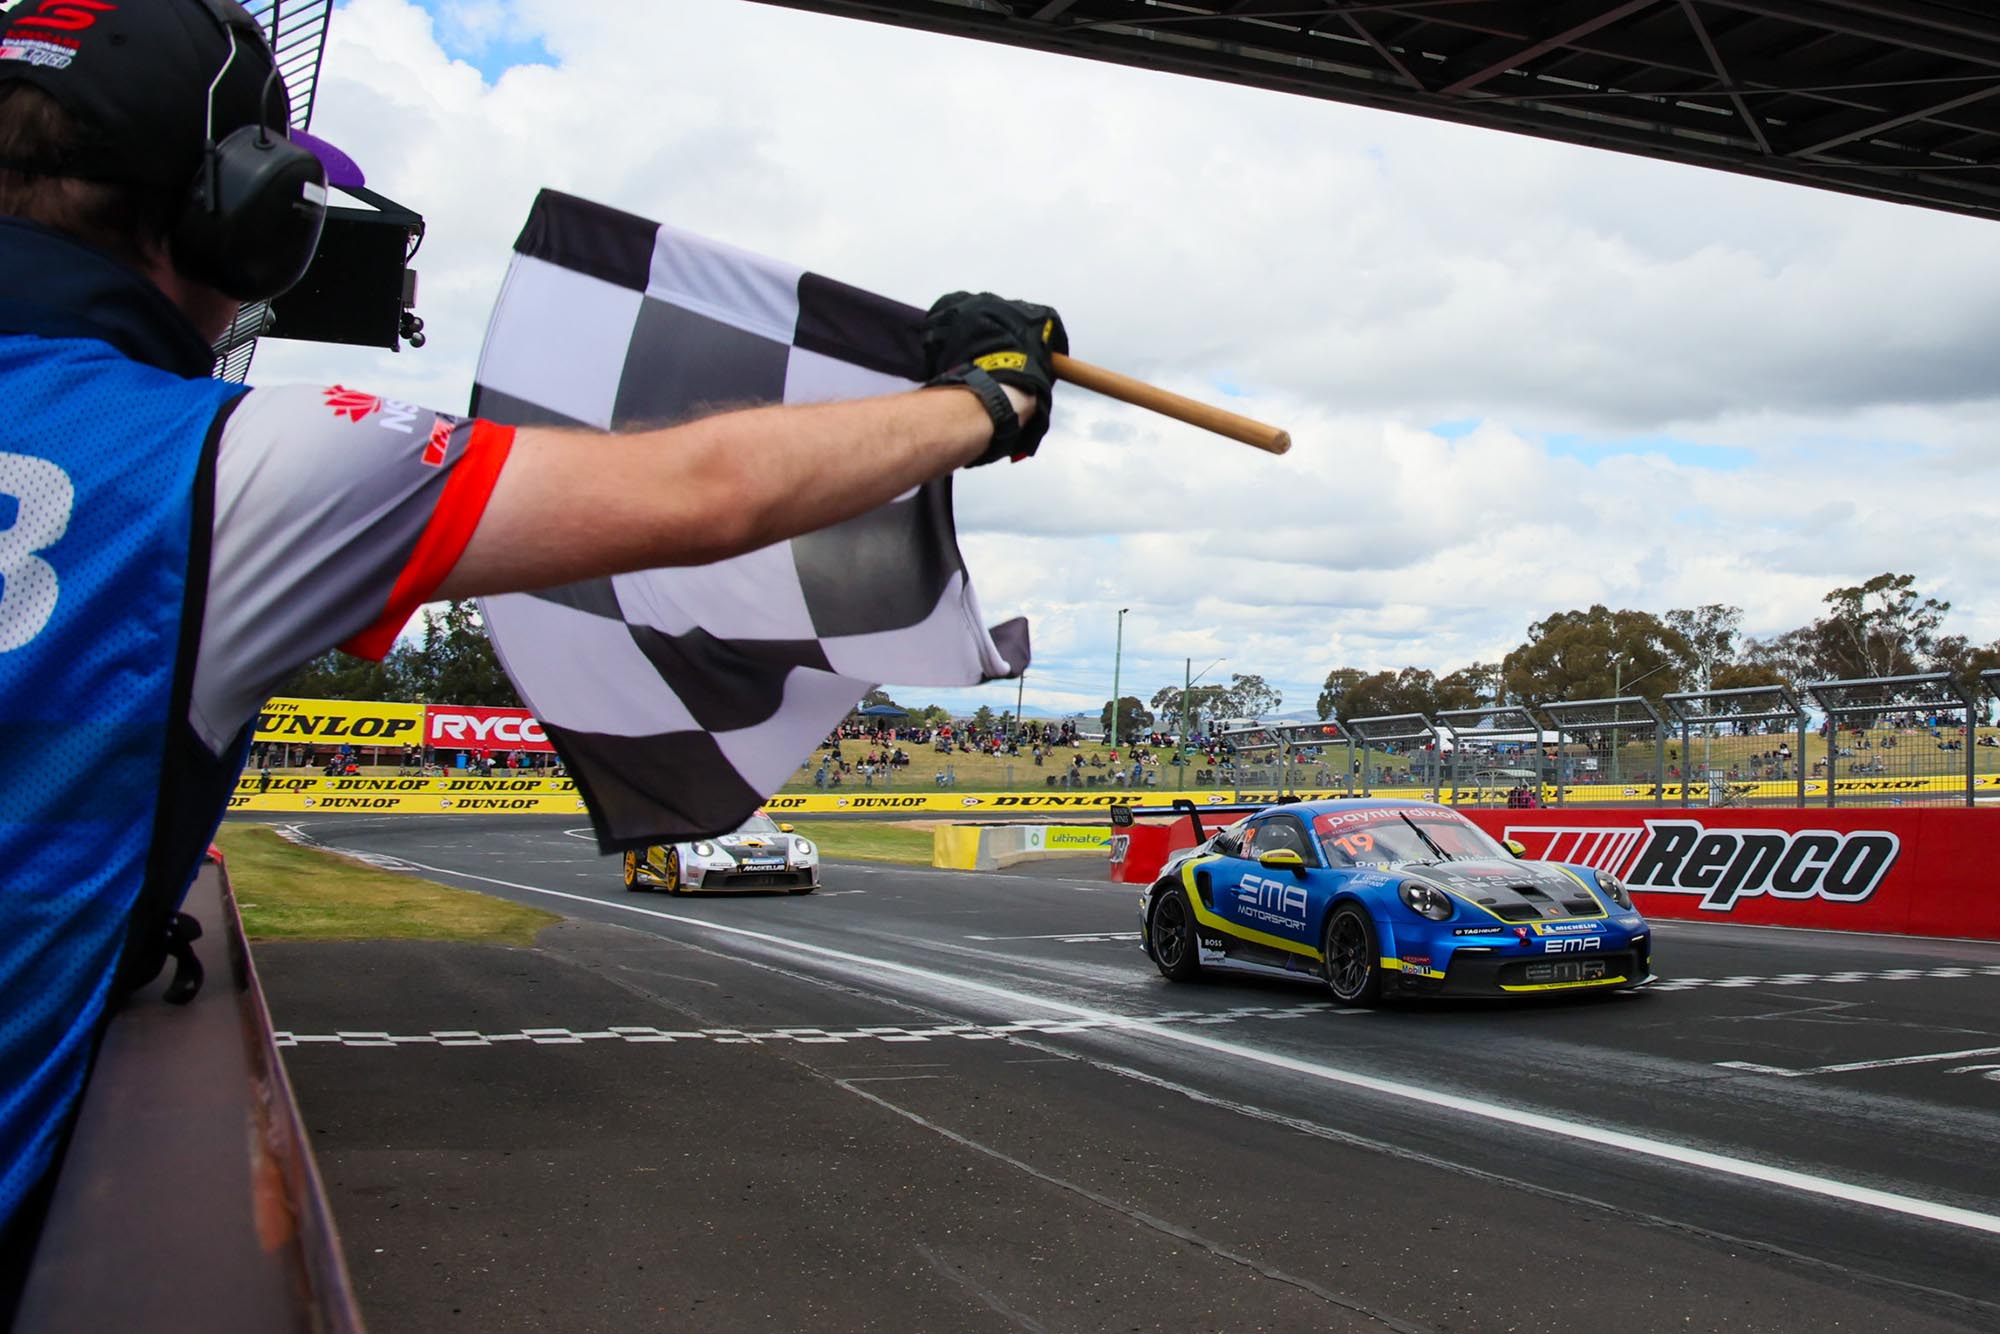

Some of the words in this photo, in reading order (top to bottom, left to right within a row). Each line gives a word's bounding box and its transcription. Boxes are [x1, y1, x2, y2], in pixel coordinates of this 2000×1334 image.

[262, 703, 299, 711] WITH
[335, 780, 429, 790] DUNLOP
[448, 780, 541, 791] DUNLOP
[1826, 780, 1930, 791] DUNLOP
[320, 798, 400, 808] DUNLOP
[456, 799, 539, 809] DUNLOP
[852, 797, 927, 808] DUNLOP
[992, 796, 1142, 806] DUNLOP
[1052, 833, 1101, 844] ultimate
[1333, 832, 1375, 858] 19
[1626, 822, 1896, 908] Repco
[1238, 873, 1308, 918] EMA
[1238, 904, 1307, 931] MOTORSPORT
[1555, 922, 1597, 932] MICHELIN
[1205, 938, 1223, 947] BOSS
[1545, 937, 1601, 953] EMA
[1526, 961, 1605, 979] EMA
